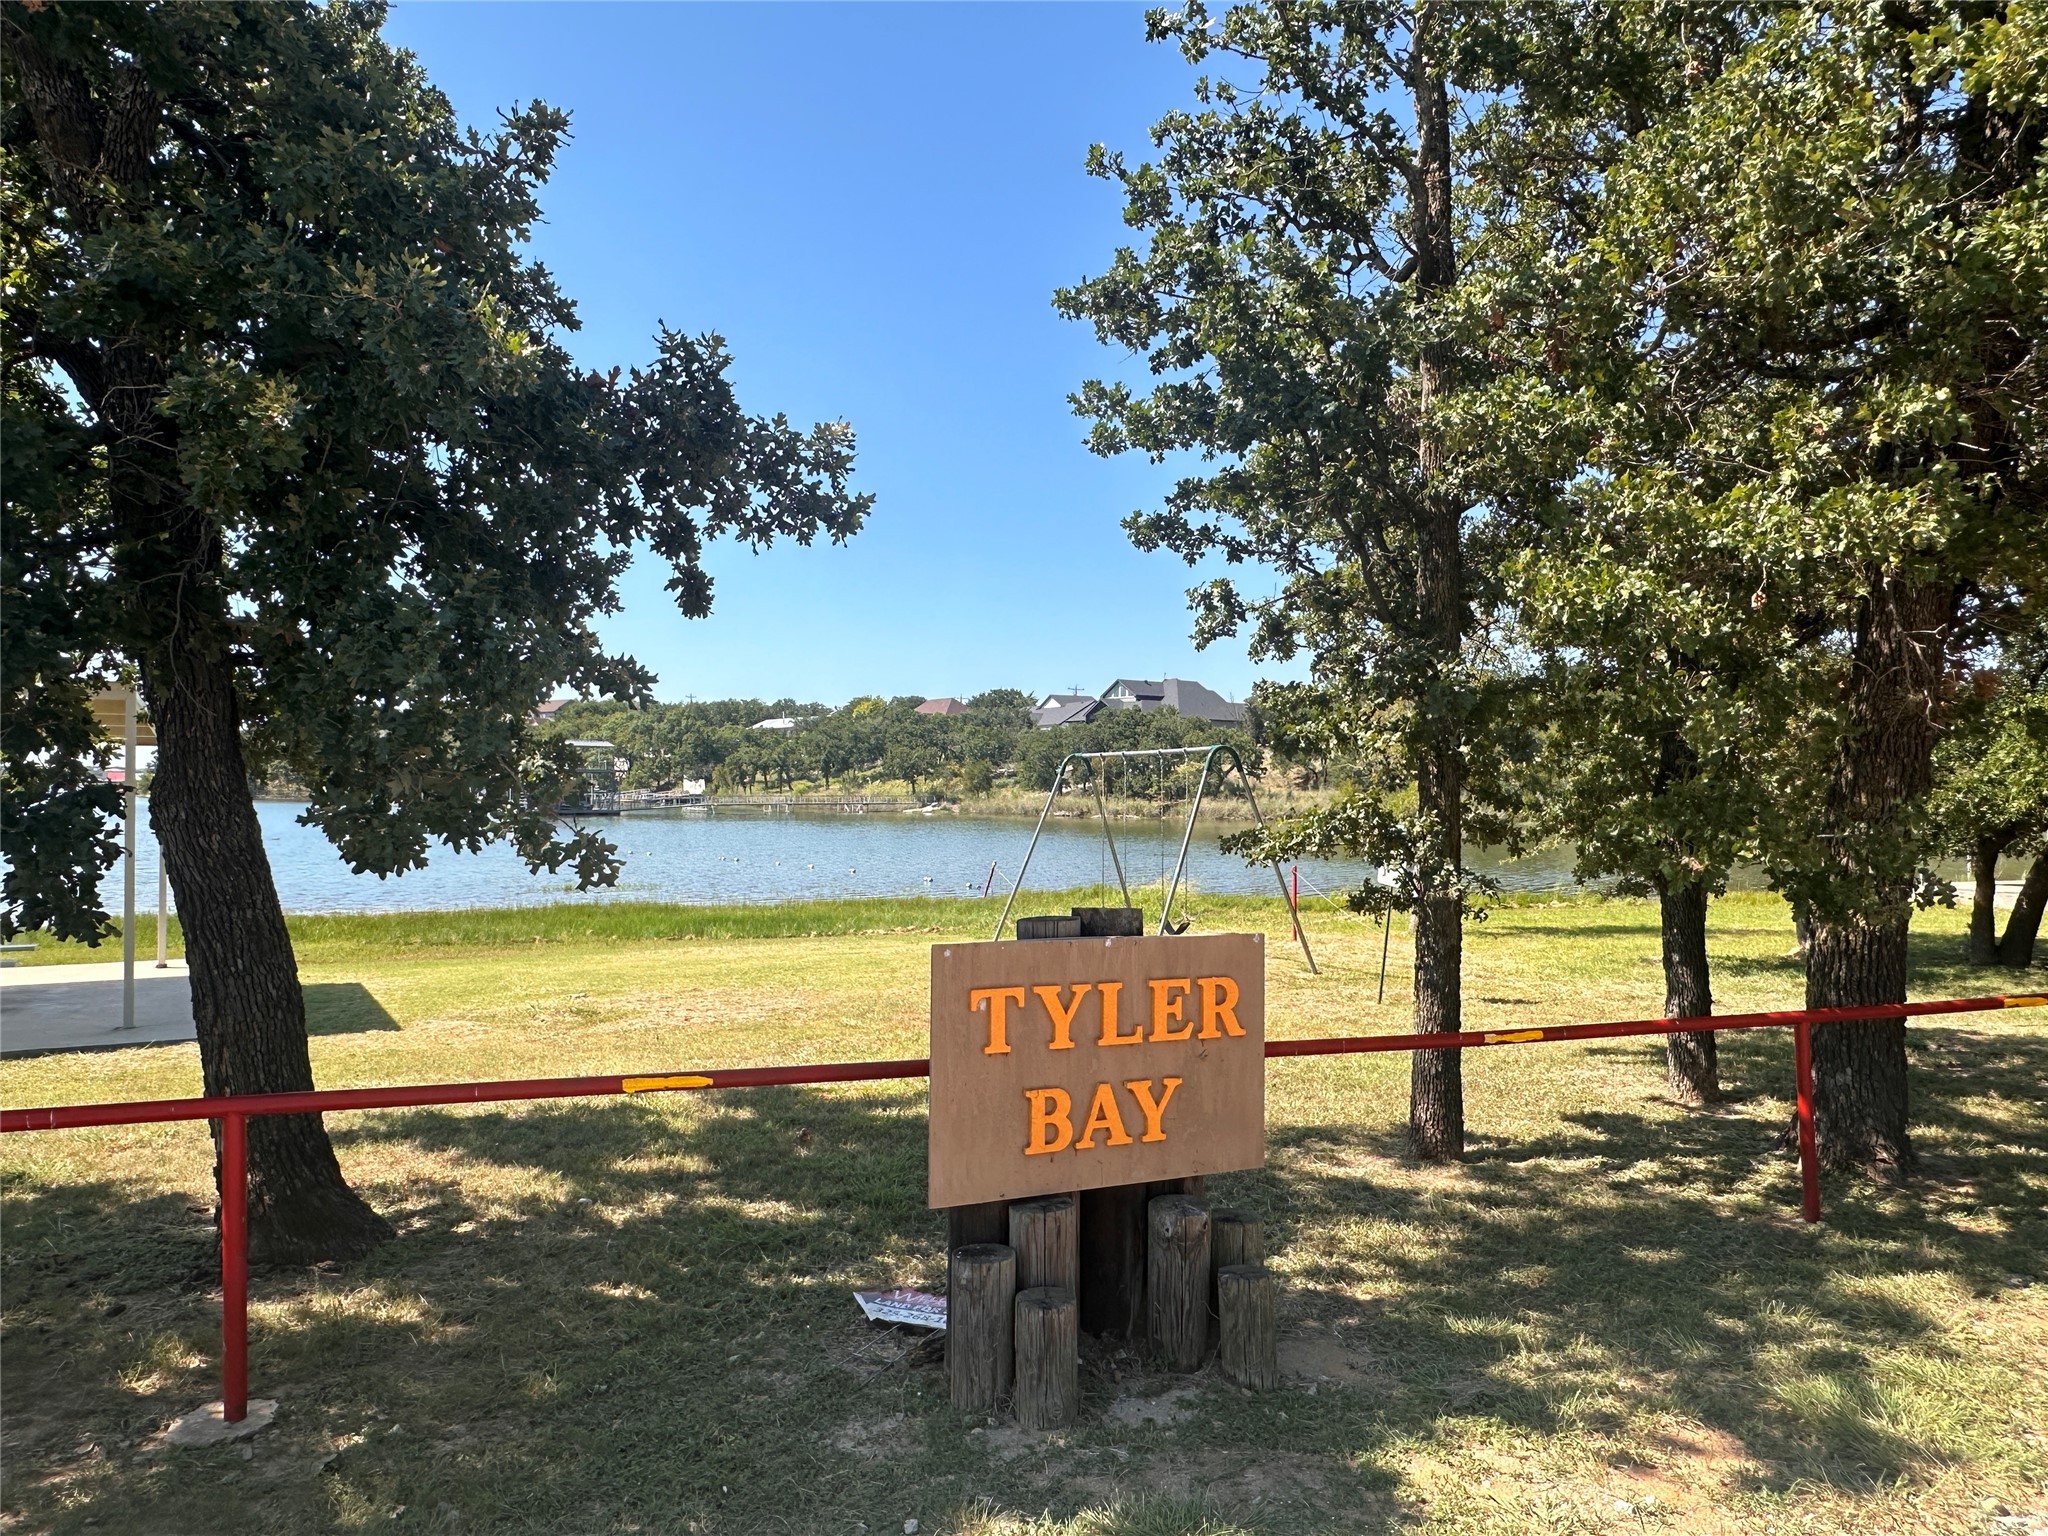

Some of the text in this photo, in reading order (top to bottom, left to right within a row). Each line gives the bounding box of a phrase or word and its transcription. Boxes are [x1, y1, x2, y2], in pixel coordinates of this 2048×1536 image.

[970, 976, 1247, 1055] TYLER
[1023, 1077, 1183, 1156] BAY
[874, 1298, 911, 1310] LAND
